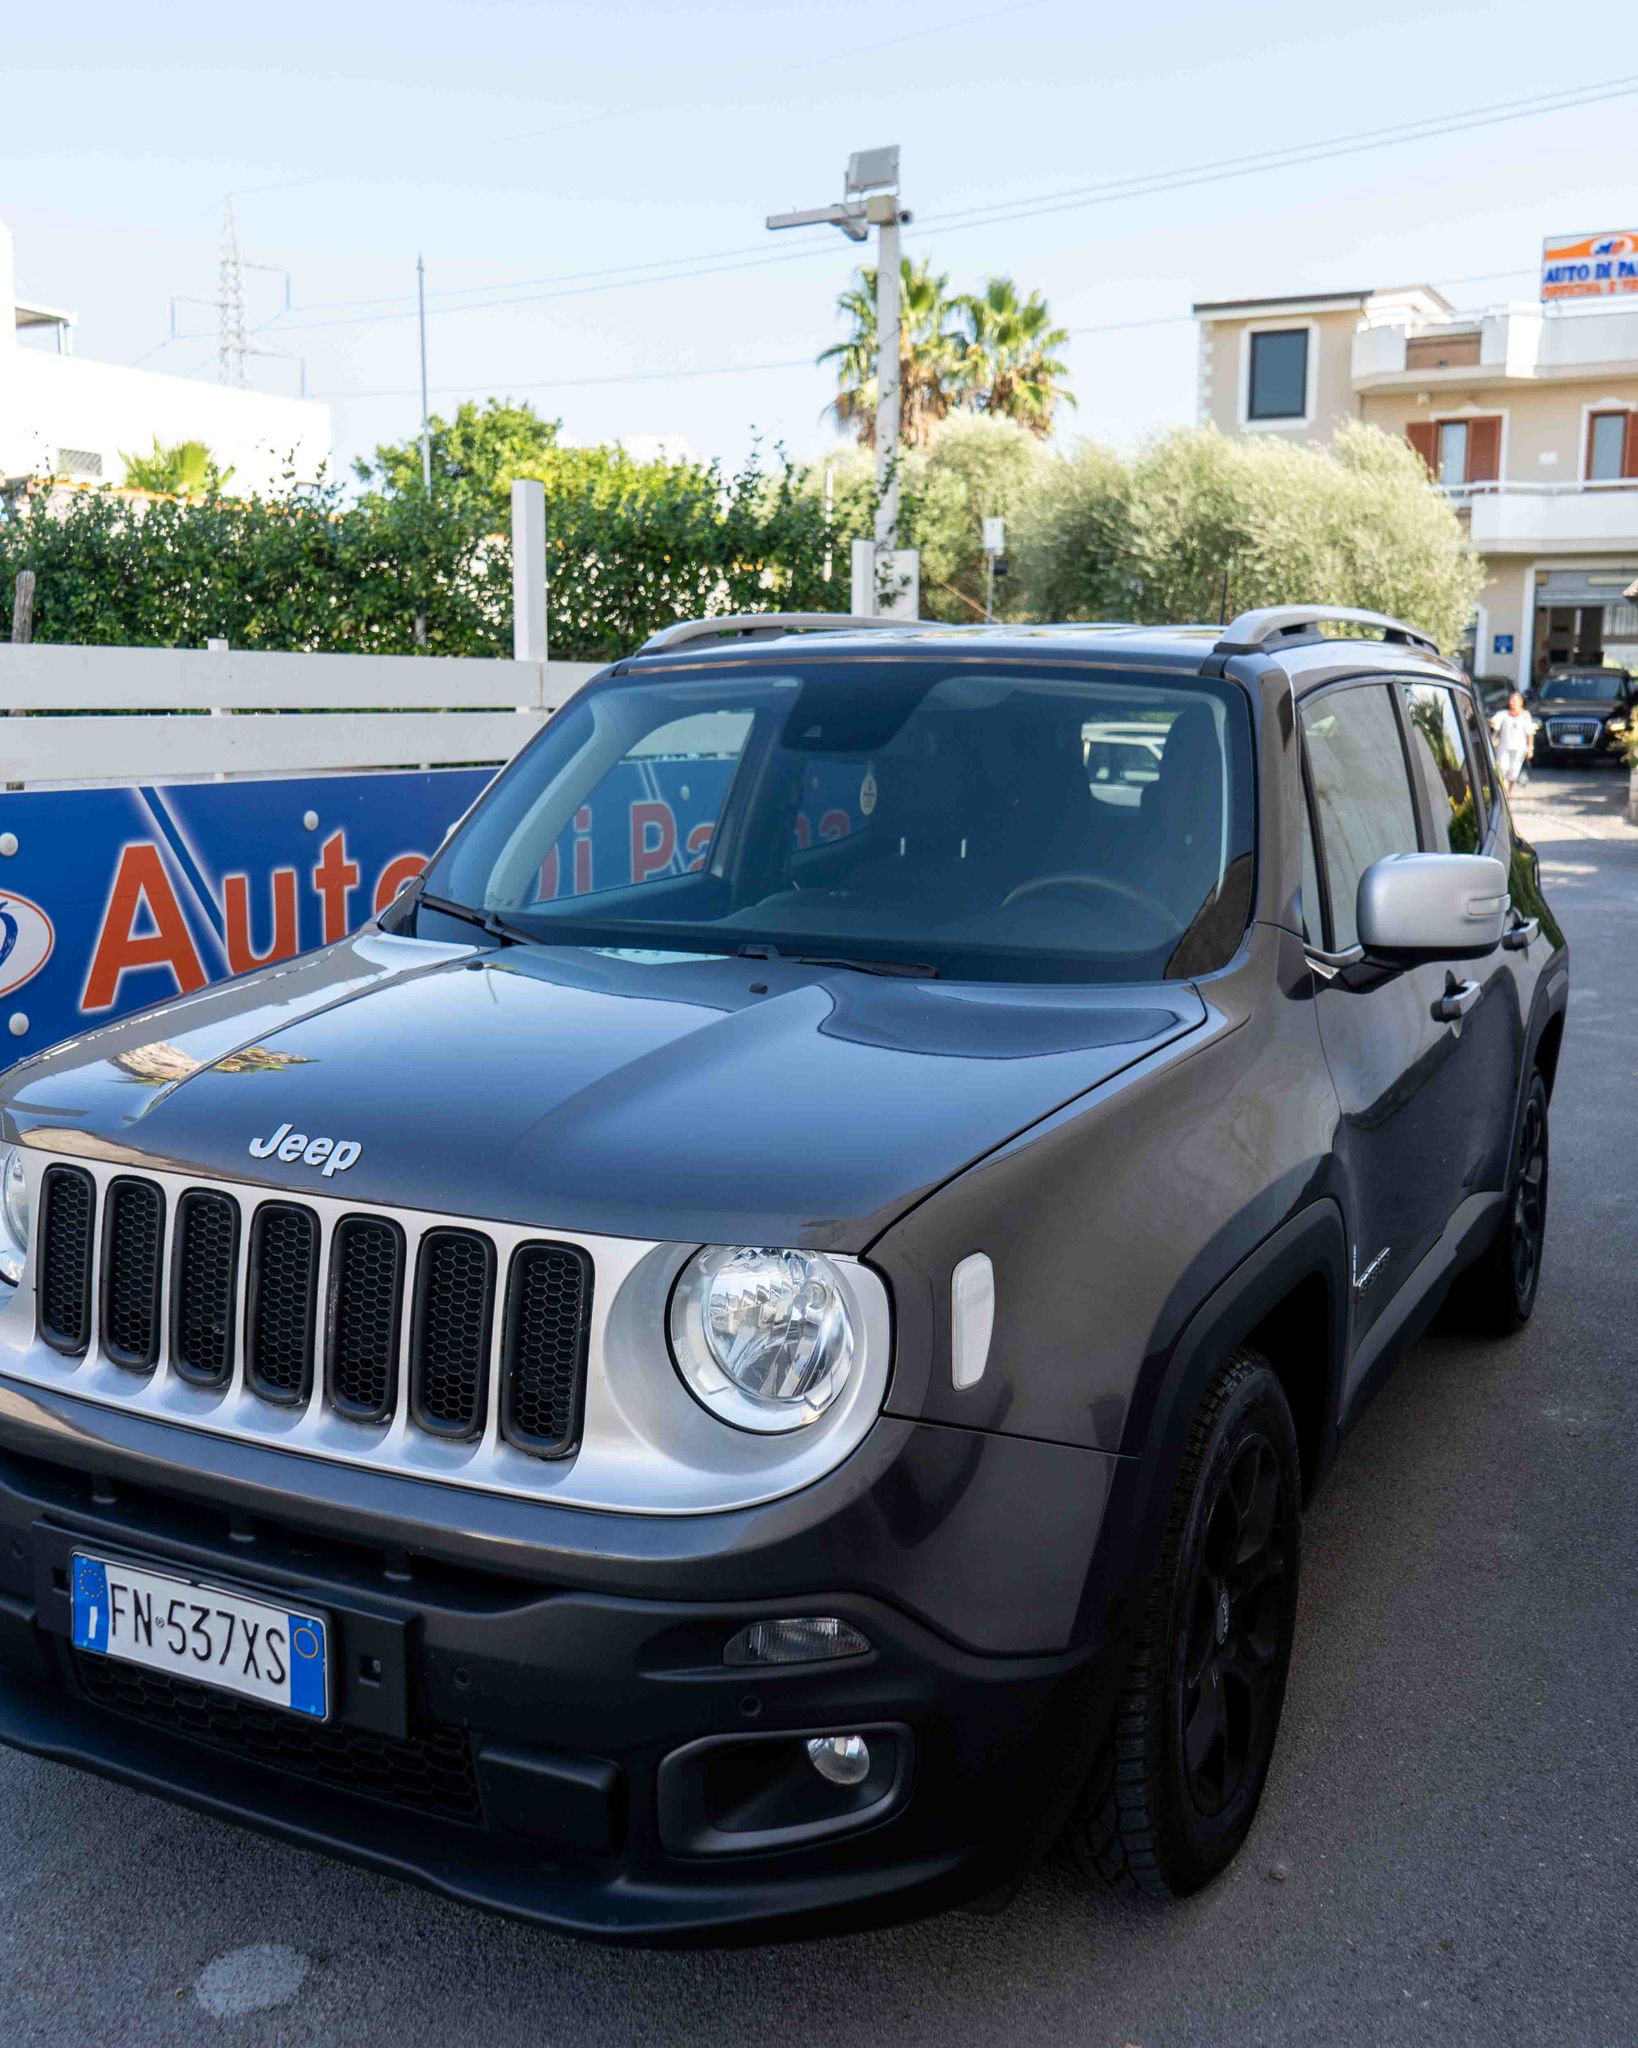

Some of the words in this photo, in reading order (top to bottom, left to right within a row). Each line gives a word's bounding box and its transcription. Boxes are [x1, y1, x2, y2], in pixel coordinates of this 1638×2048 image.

[1545, 265, 1590, 282] AUTO
[1617, 260, 1638, 278] PA
[249, 1123, 362, 1177] Jeep
